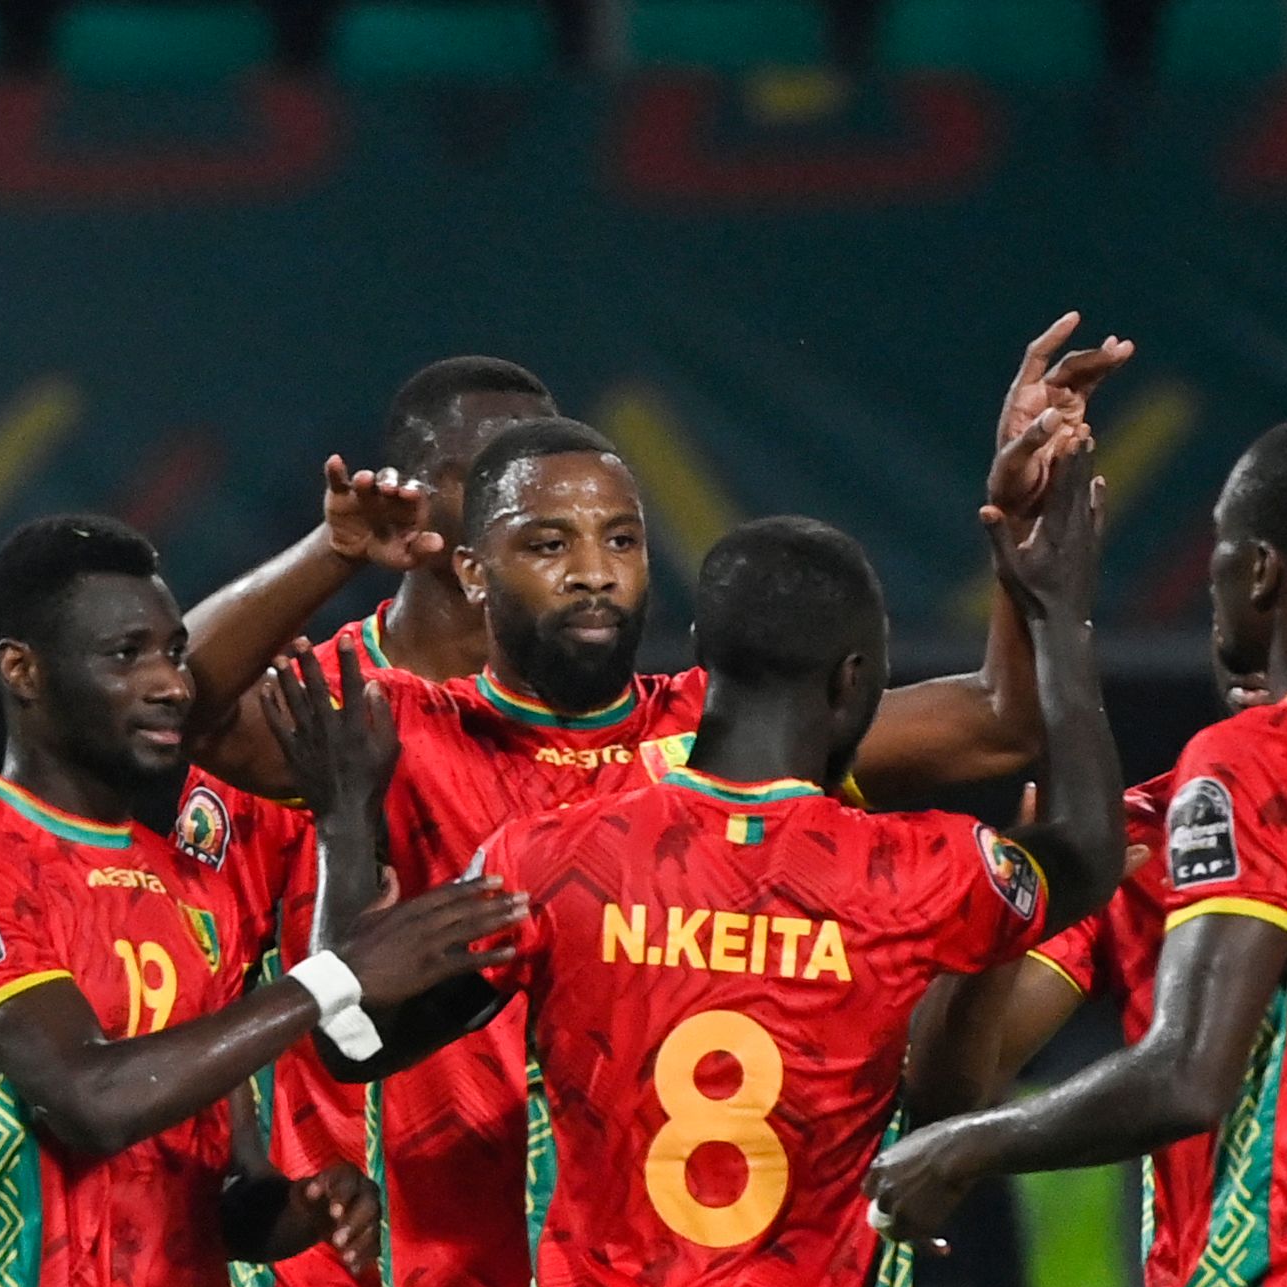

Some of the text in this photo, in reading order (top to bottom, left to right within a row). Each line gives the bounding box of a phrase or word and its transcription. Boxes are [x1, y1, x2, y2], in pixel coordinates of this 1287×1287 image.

[114, 938, 177, 1038] 19
[602, 902, 852, 982] N.KEITA
[645, 1010, 789, 1248] 8
